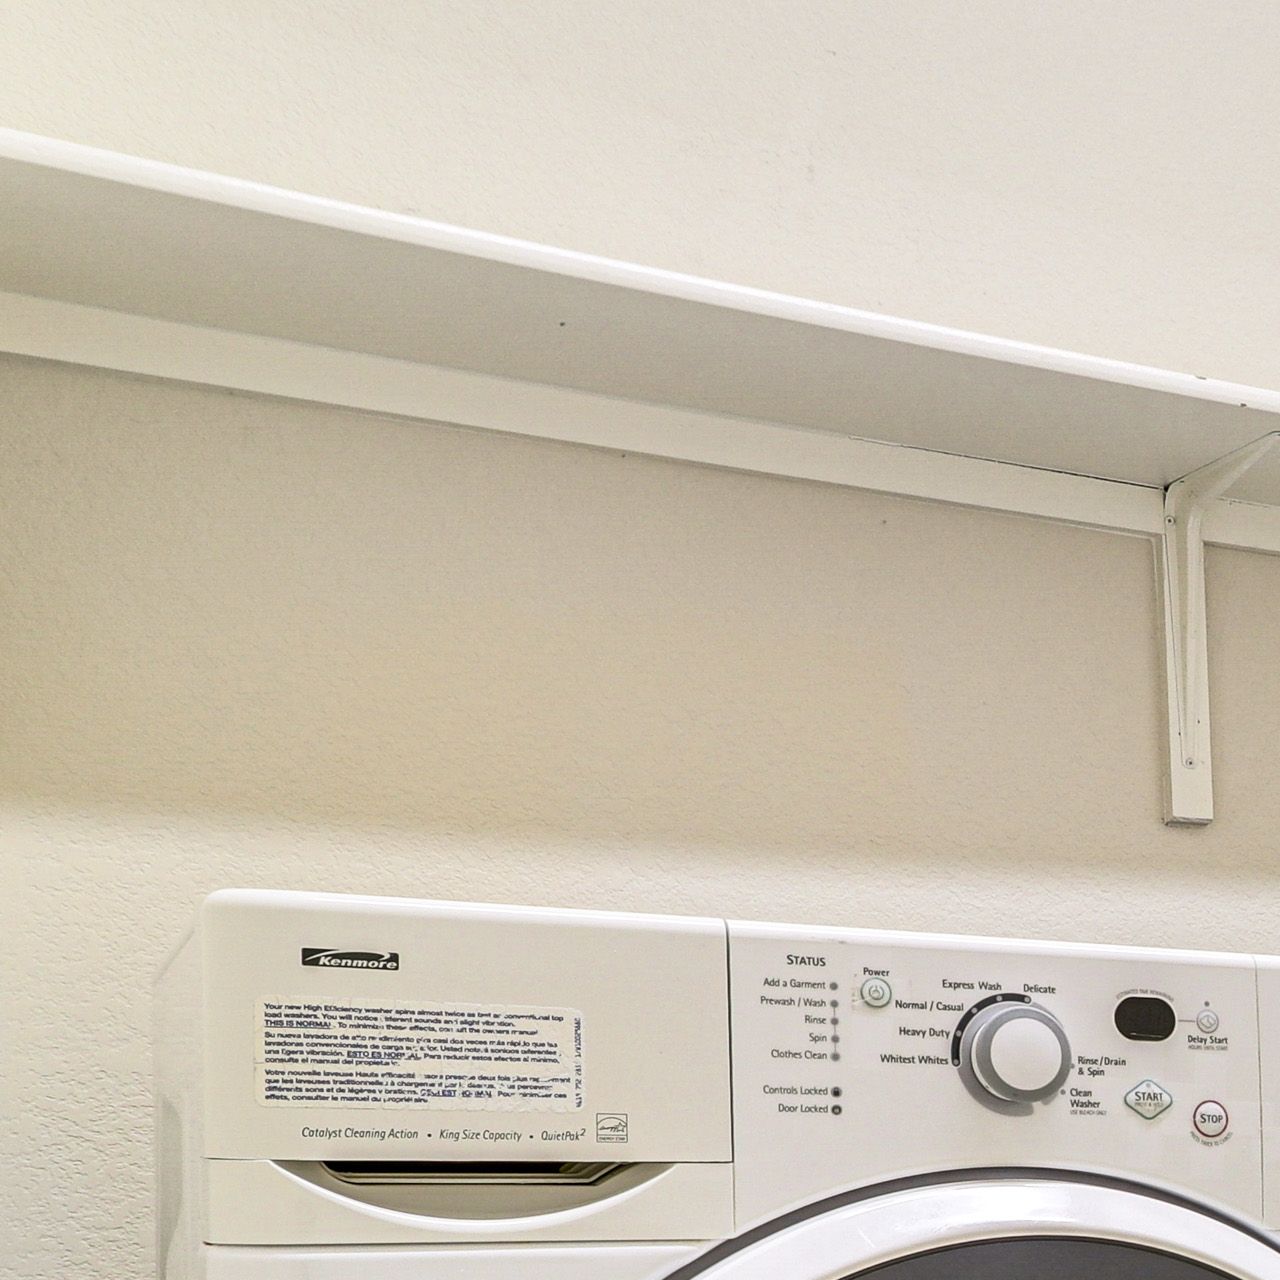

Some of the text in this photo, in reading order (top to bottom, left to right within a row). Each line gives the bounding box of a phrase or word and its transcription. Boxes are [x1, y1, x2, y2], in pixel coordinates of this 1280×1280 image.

[319, 956, 397, 969] Kenmore
[786, 954, 826, 966] STATUS
[863, 967, 890, 977] Power
[763, 978, 780, 987] Add
[790, 979, 826, 989] Garment
[942, 979, 1002, 992] Express Wash
[1023, 984, 1056, 994] Delicate
[760, 996, 827, 1007] Prewash Wash
[895, 1000, 964, 1012] Normal Casual
[303, 1004, 322, 1012] High
[804, 1015, 826, 1024] Rinse
[809, 1032, 827, 1043] Spin
[899, 1027, 950, 1039] Heavy Duty
[1187, 1035, 1228, 1045] Delay Start
[771, 1049, 827, 1060] Clothes Clean
[880, 1054, 949, 1065] Whitest Whites
[1078, 1067, 1105, 1077] & Spin
[763, 1085, 828, 1096] Controls Locked
[1070, 1088, 1092, 1097] Clean
[1134, 1091, 1163, 1102] START
[778, 1104, 828, 1113] Door Locked
[1070, 1100, 1101, 1109] Washer
[1200, 1113, 1224, 1124] STOP
[301, 1127, 342, 1139] Catalyst
[344, 1127, 385, 1140] Cleaning
[387, 1128, 419, 1139] Action
[439, 1129, 459, 1141] King
[461, 1129, 480, 1140] Size
[482, 1130, 522, 1142] Capacity
